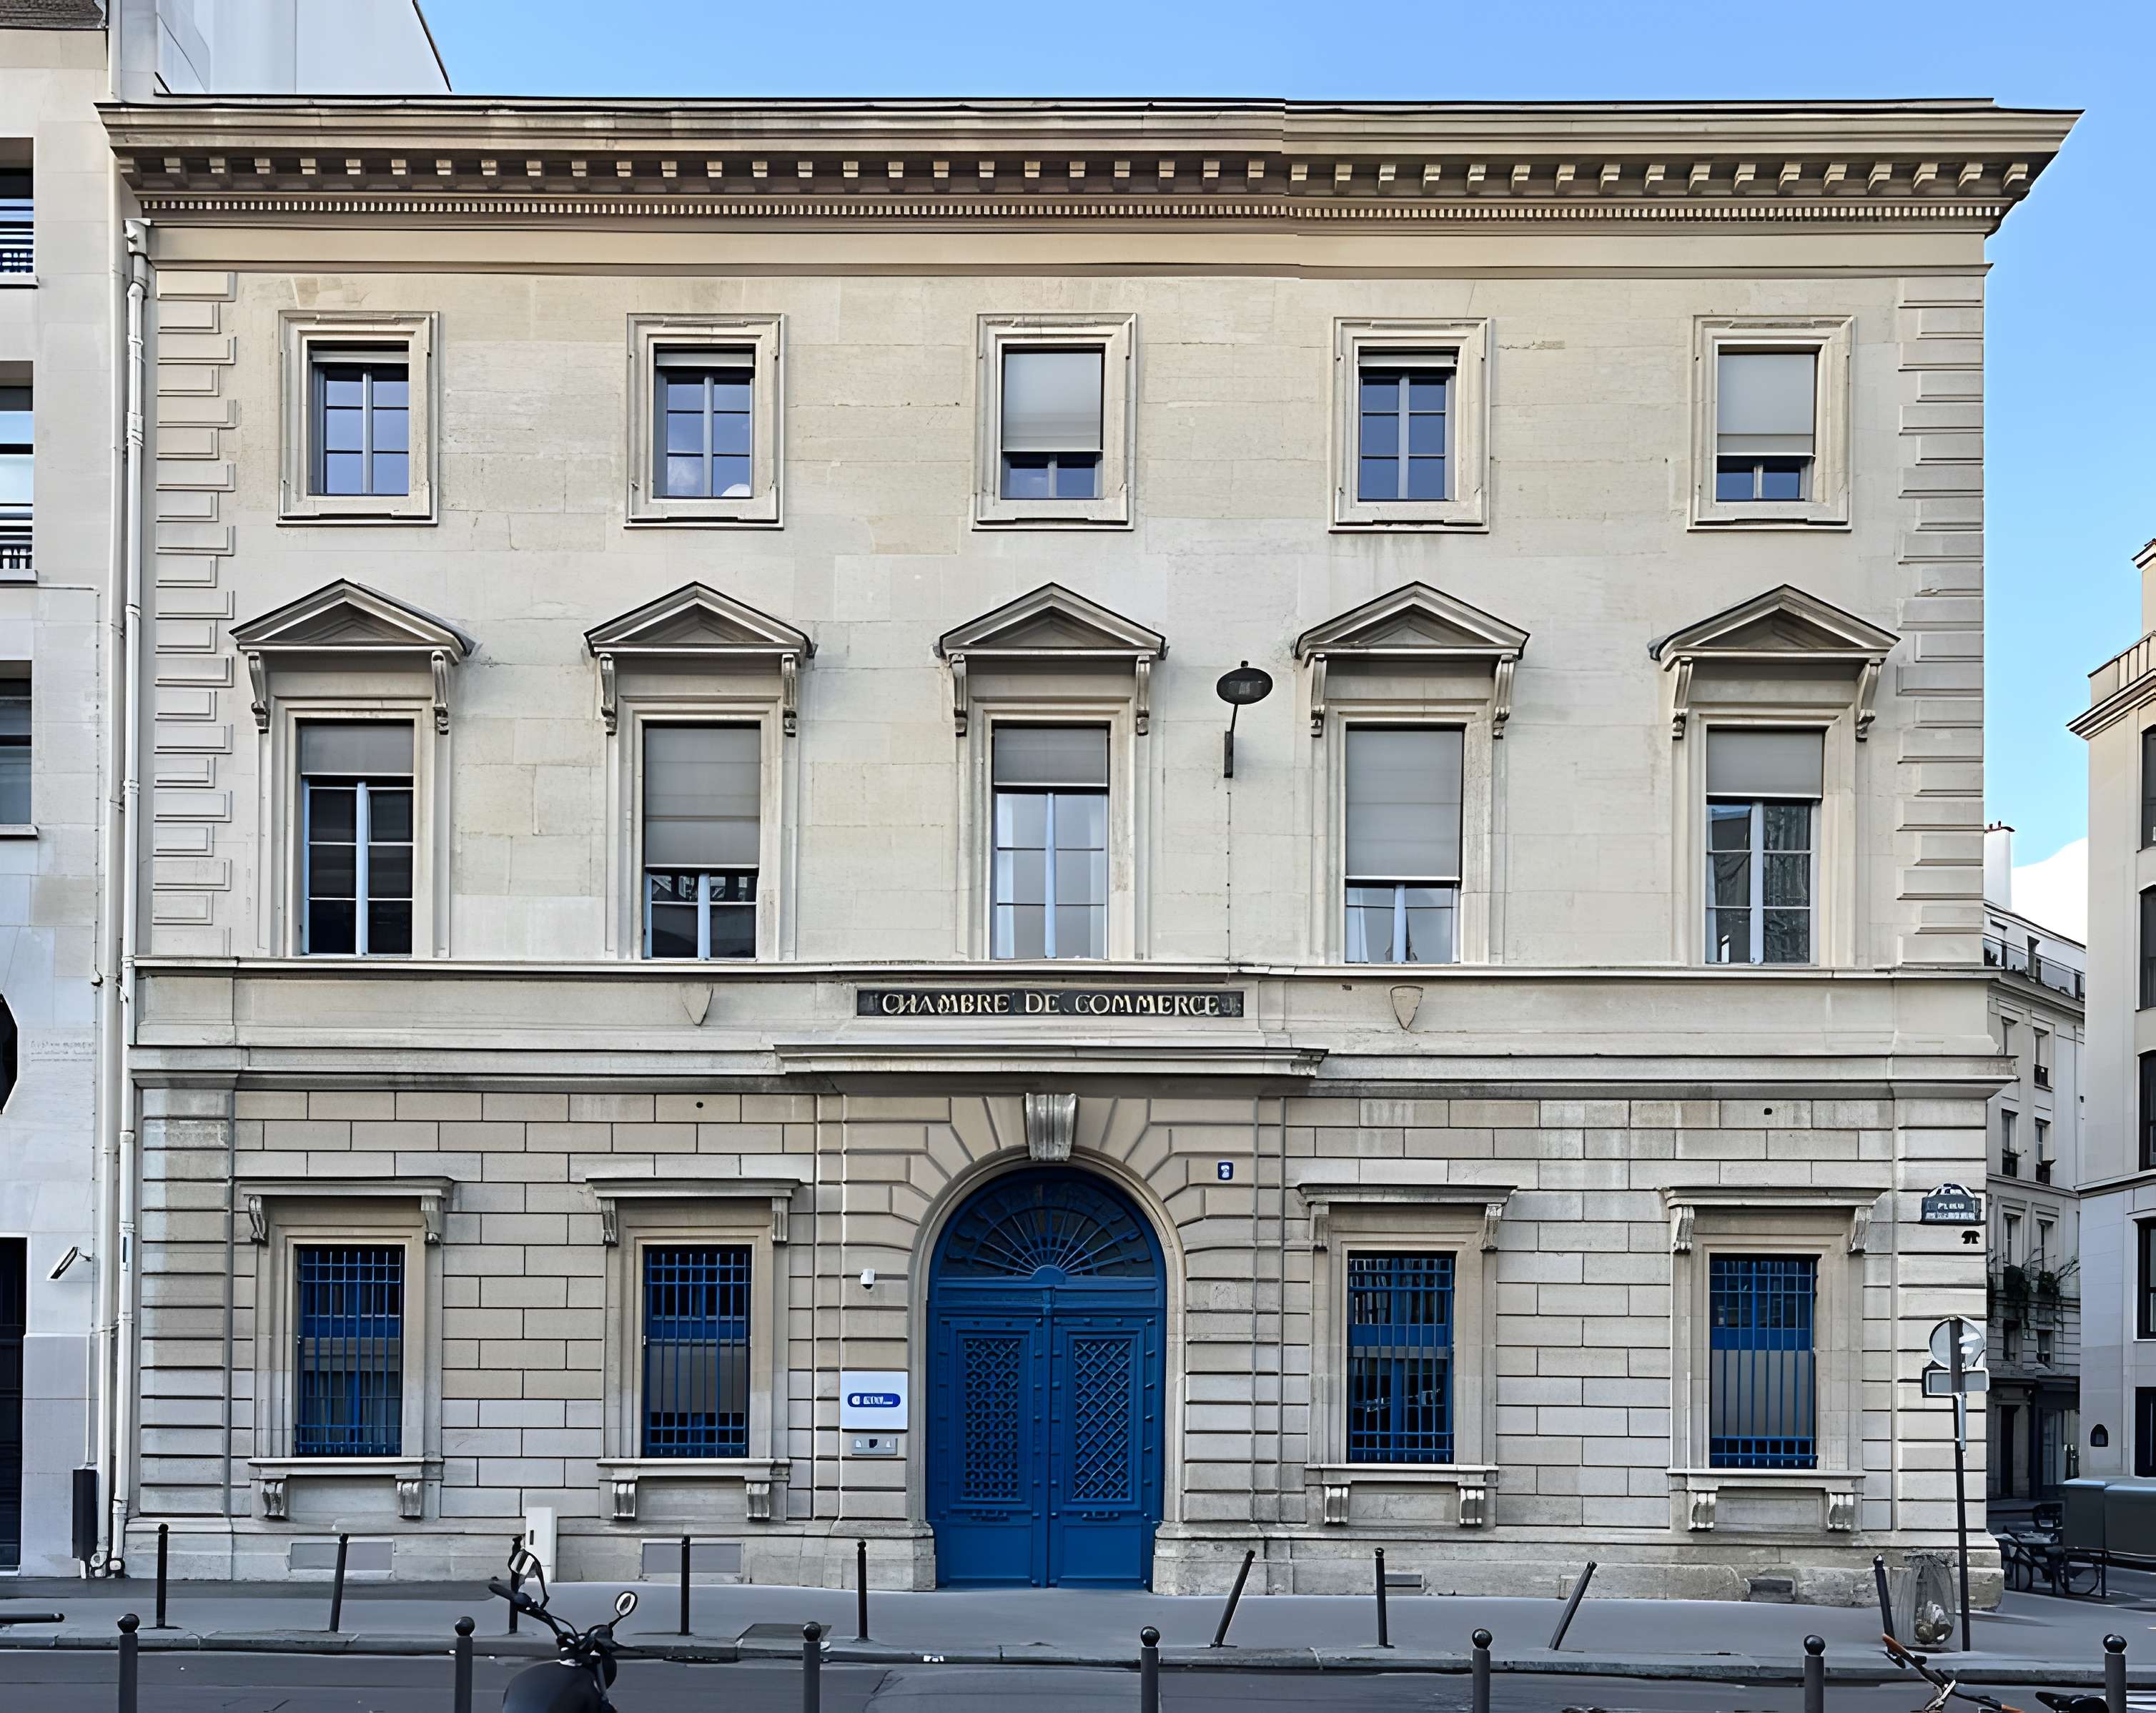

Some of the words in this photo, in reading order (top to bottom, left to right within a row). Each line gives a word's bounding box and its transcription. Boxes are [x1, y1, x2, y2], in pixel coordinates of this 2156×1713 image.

[881, 993, 1011, 1015] CHAMBRE
[1025, 992, 1060, 1015] DE
[1075, 994, 1220, 1017] COMMERCE
